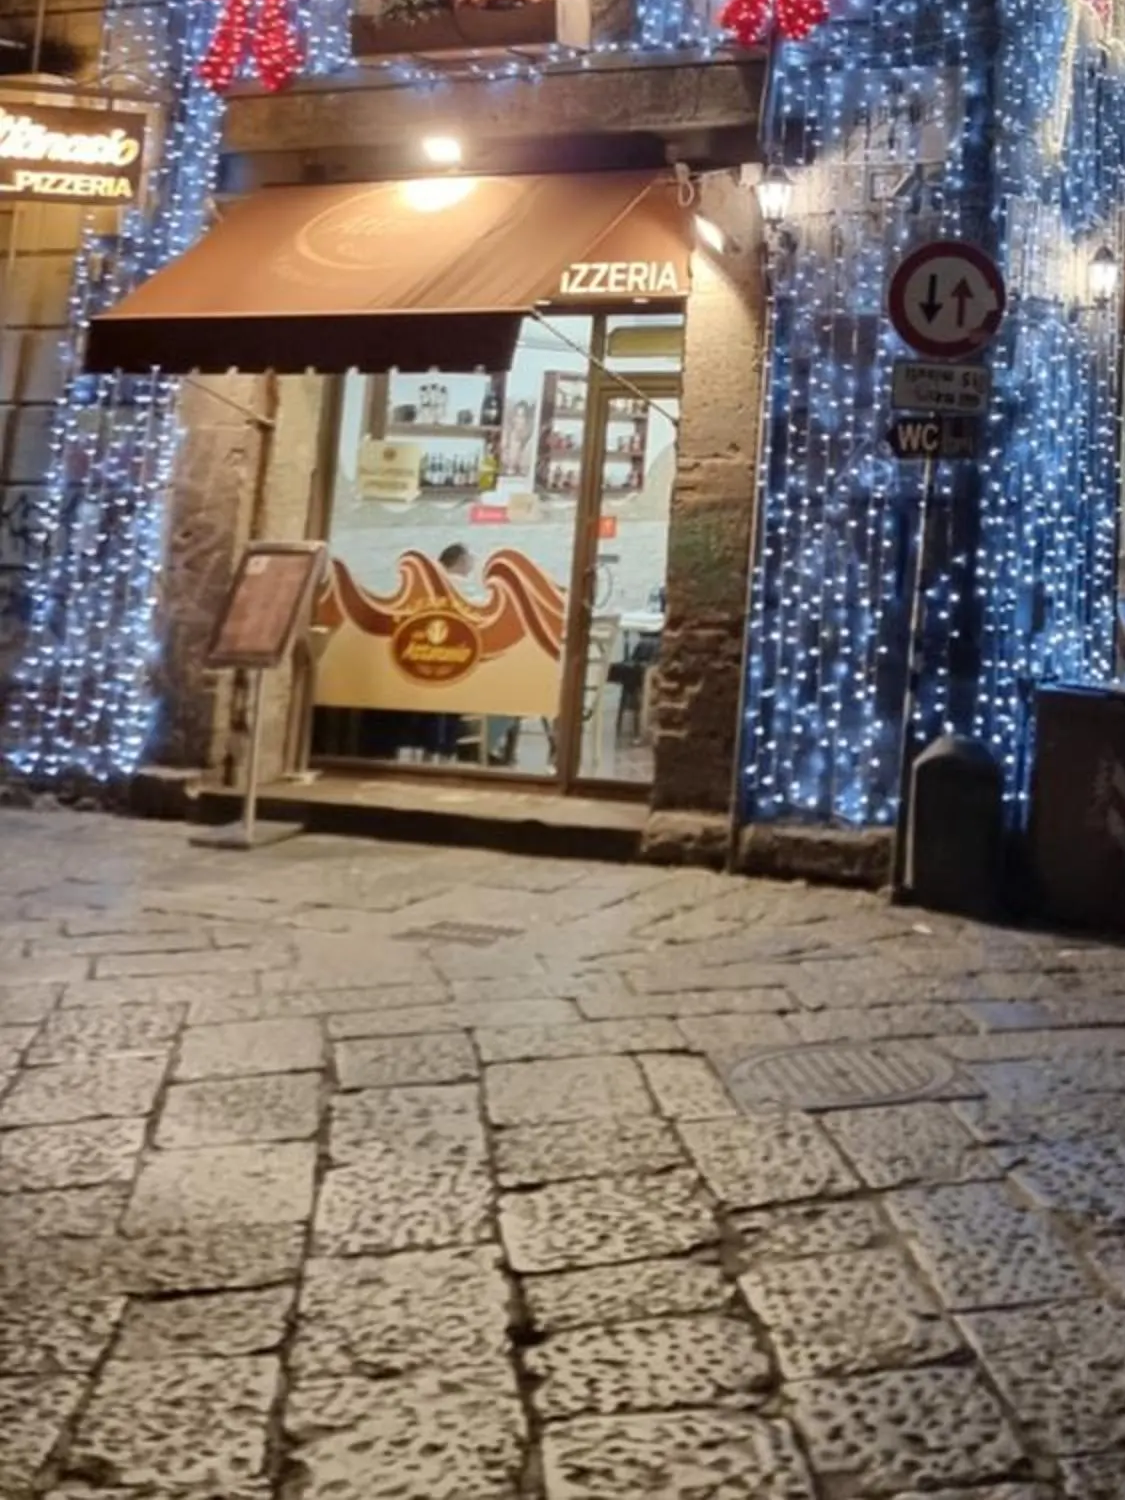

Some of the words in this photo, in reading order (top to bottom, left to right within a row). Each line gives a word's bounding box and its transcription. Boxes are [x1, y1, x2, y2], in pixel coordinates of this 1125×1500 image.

[14, 170, 133, 197] PIZZERIA
[560, 261, 678, 293] IZZERIA
[897, 422, 940, 452] WC
